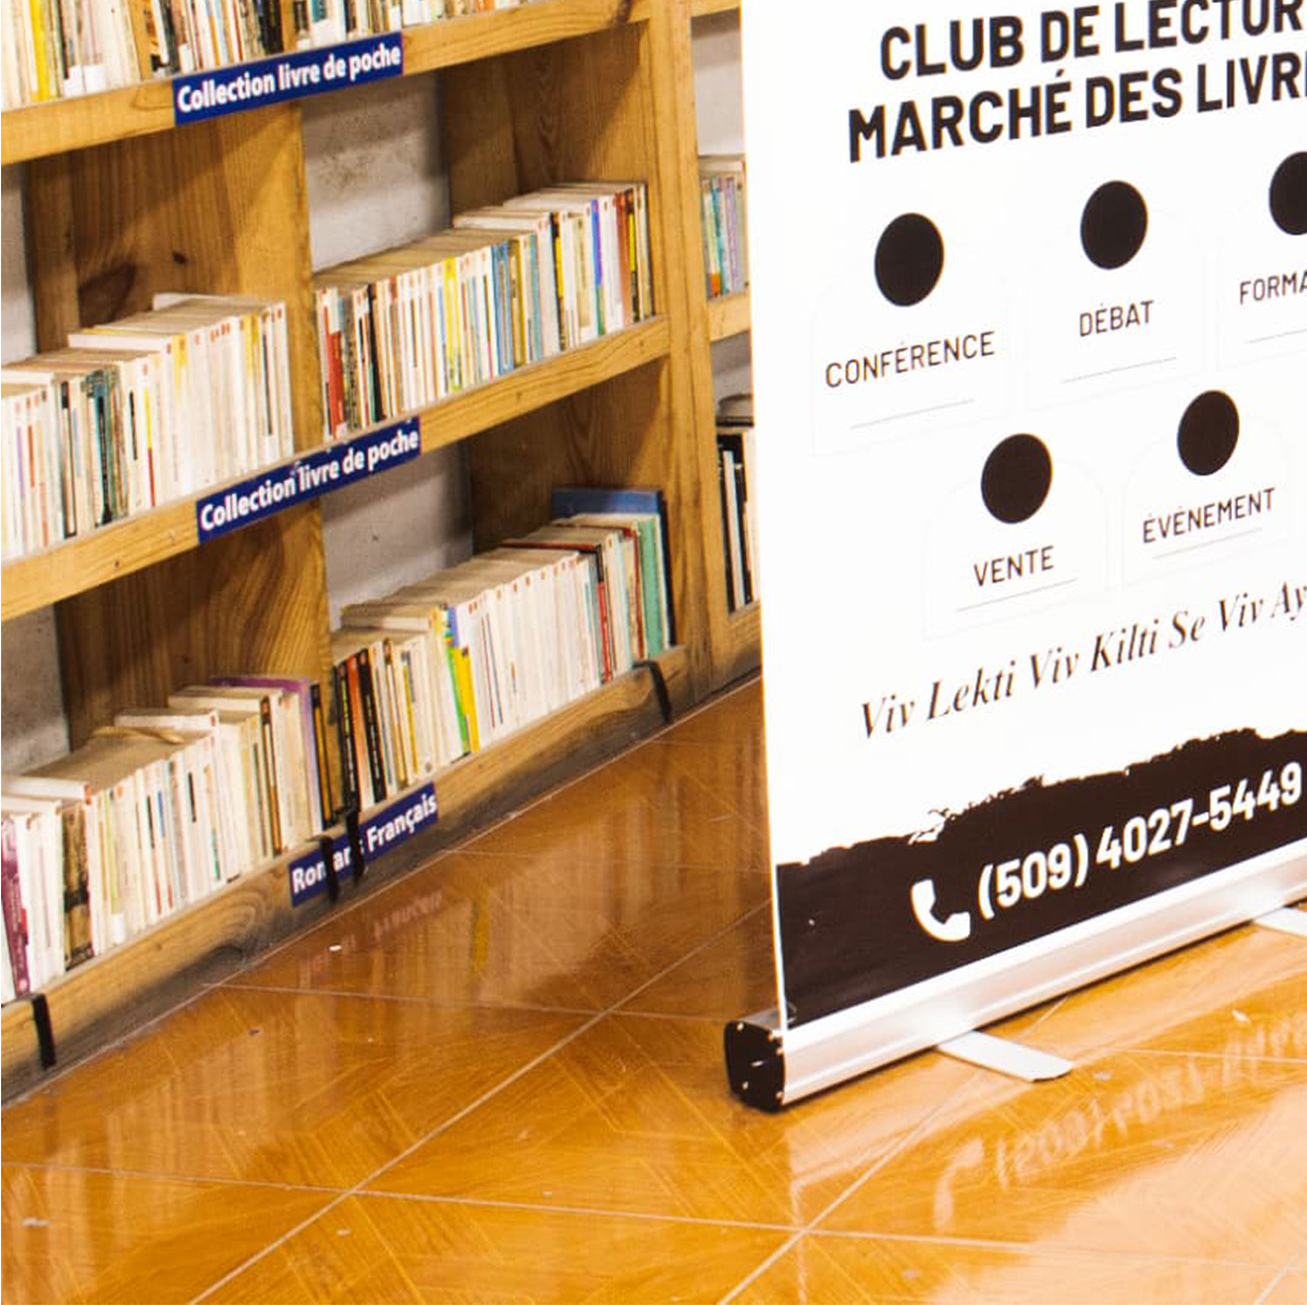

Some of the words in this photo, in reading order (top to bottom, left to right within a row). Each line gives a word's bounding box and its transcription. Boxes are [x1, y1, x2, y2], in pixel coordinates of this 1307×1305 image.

[177, 72, 275, 113] Collection
[278, 55, 320, 91] livre
[322, 53, 346, 80] de
[348, 43, 400, 80] poche
[880, 15, 1024, 81] CLUB
[1040, 4, 1101, 63] DE
[847, 67, 1073, 163] MARCHÉ
[1085, 67, 1183, 129] DES
[1079, 299, 1155, 338] DÉBAT
[824, 330, 996, 389] CONFÉRENCE
[200, 473, 297, 532] Collection
[297, 465, 341, 492] livre
[342, 447, 365, 475] de
[367, 429, 419, 472] poche
[973, 544, 1056, 588] VENTE
[861, 694, 916, 739] Viv
[926, 660, 1017, 721] Lekti
[1029, 648, 1080, 689] Viv
[1090, 618, 1160, 672] Kilti
[1169, 610, 1205, 649] Se
[1217, 592, 1265, 633] Viv
[366, 793, 438, 853] Français
[978, 832, 1089, 921] (509)
[1096, 761, 1303, 870] 4027-5449
